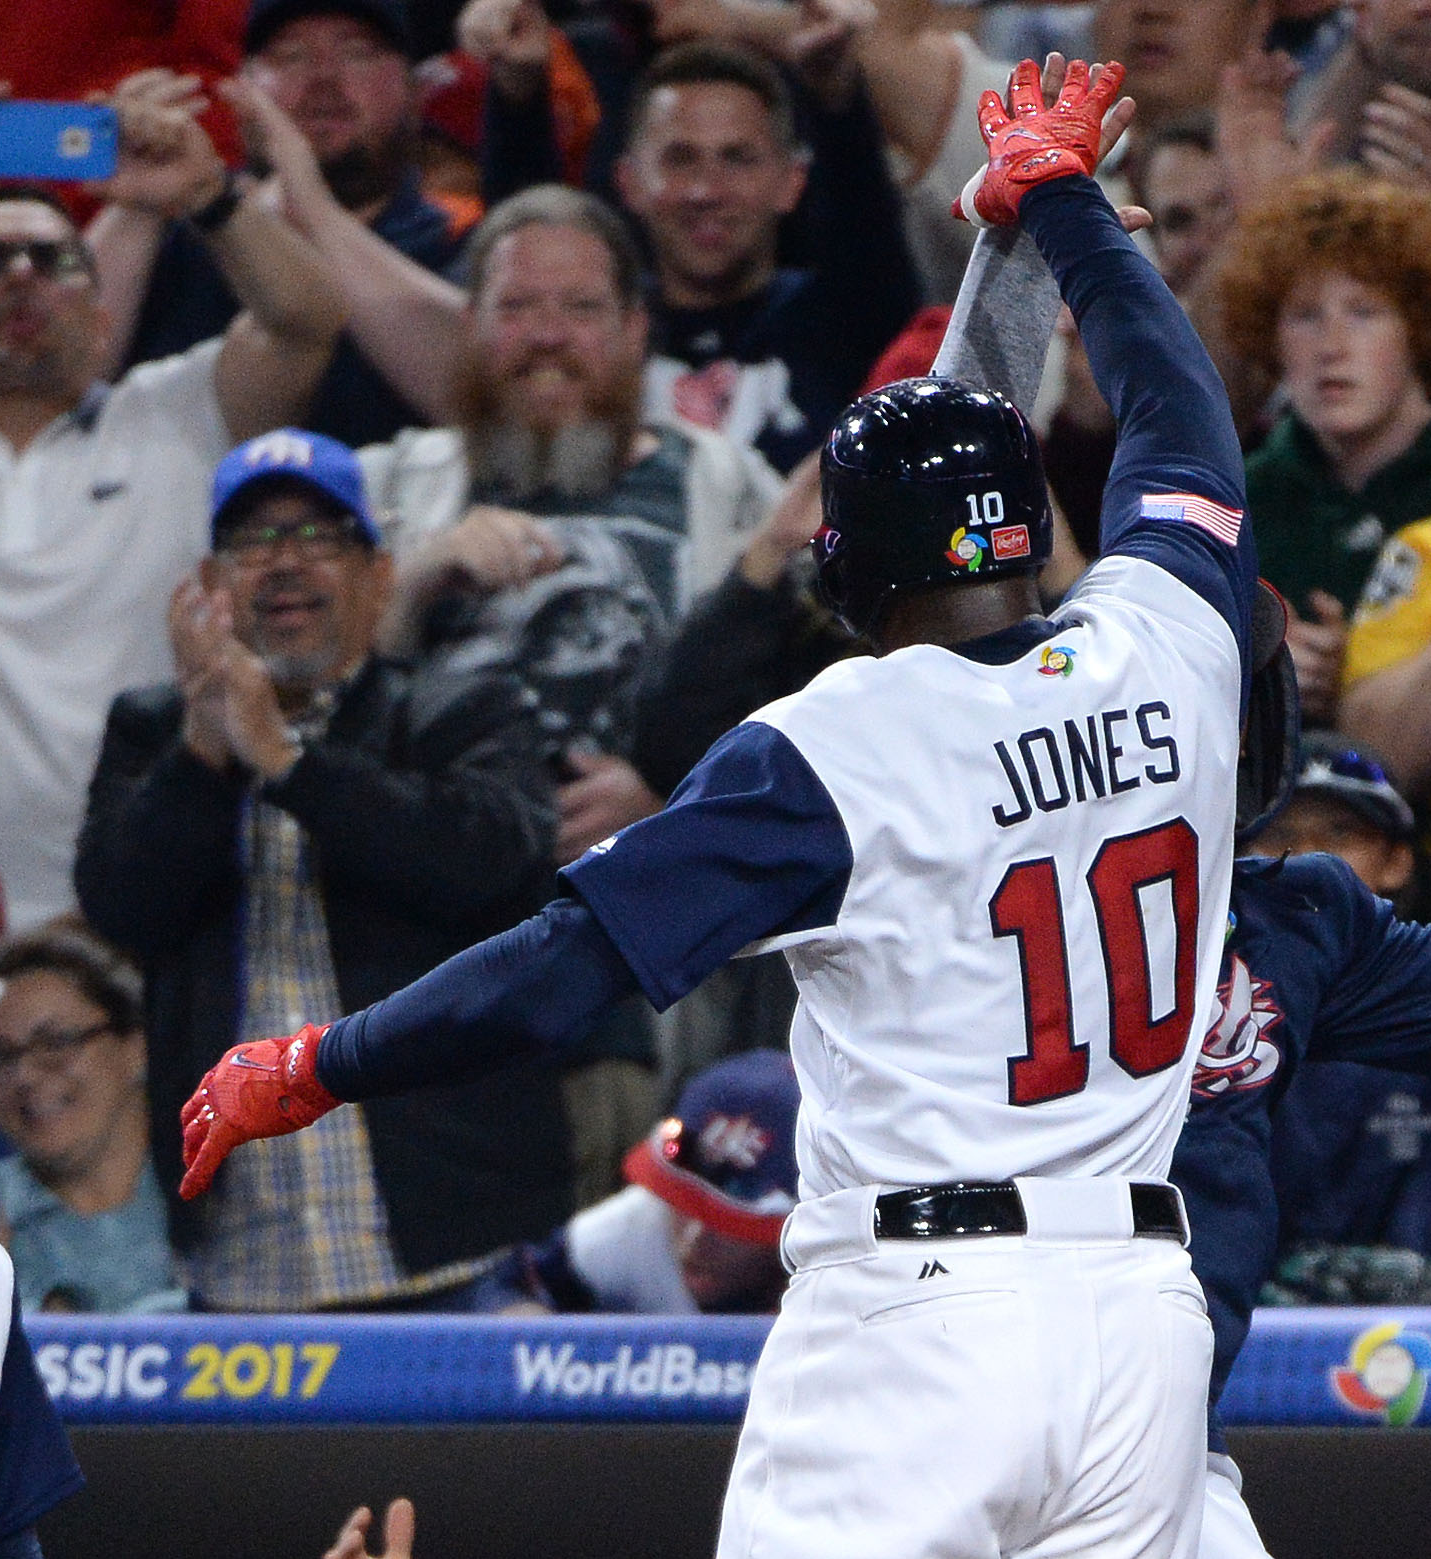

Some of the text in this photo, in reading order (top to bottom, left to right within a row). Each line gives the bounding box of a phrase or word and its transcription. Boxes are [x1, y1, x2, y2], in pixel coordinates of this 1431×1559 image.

[965, 491, 1005, 527] 10
[991, 700, 1181, 829] JONES
[987, 814, 1200, 1108] 10
[181, 1342, 341, 1400] 2017
